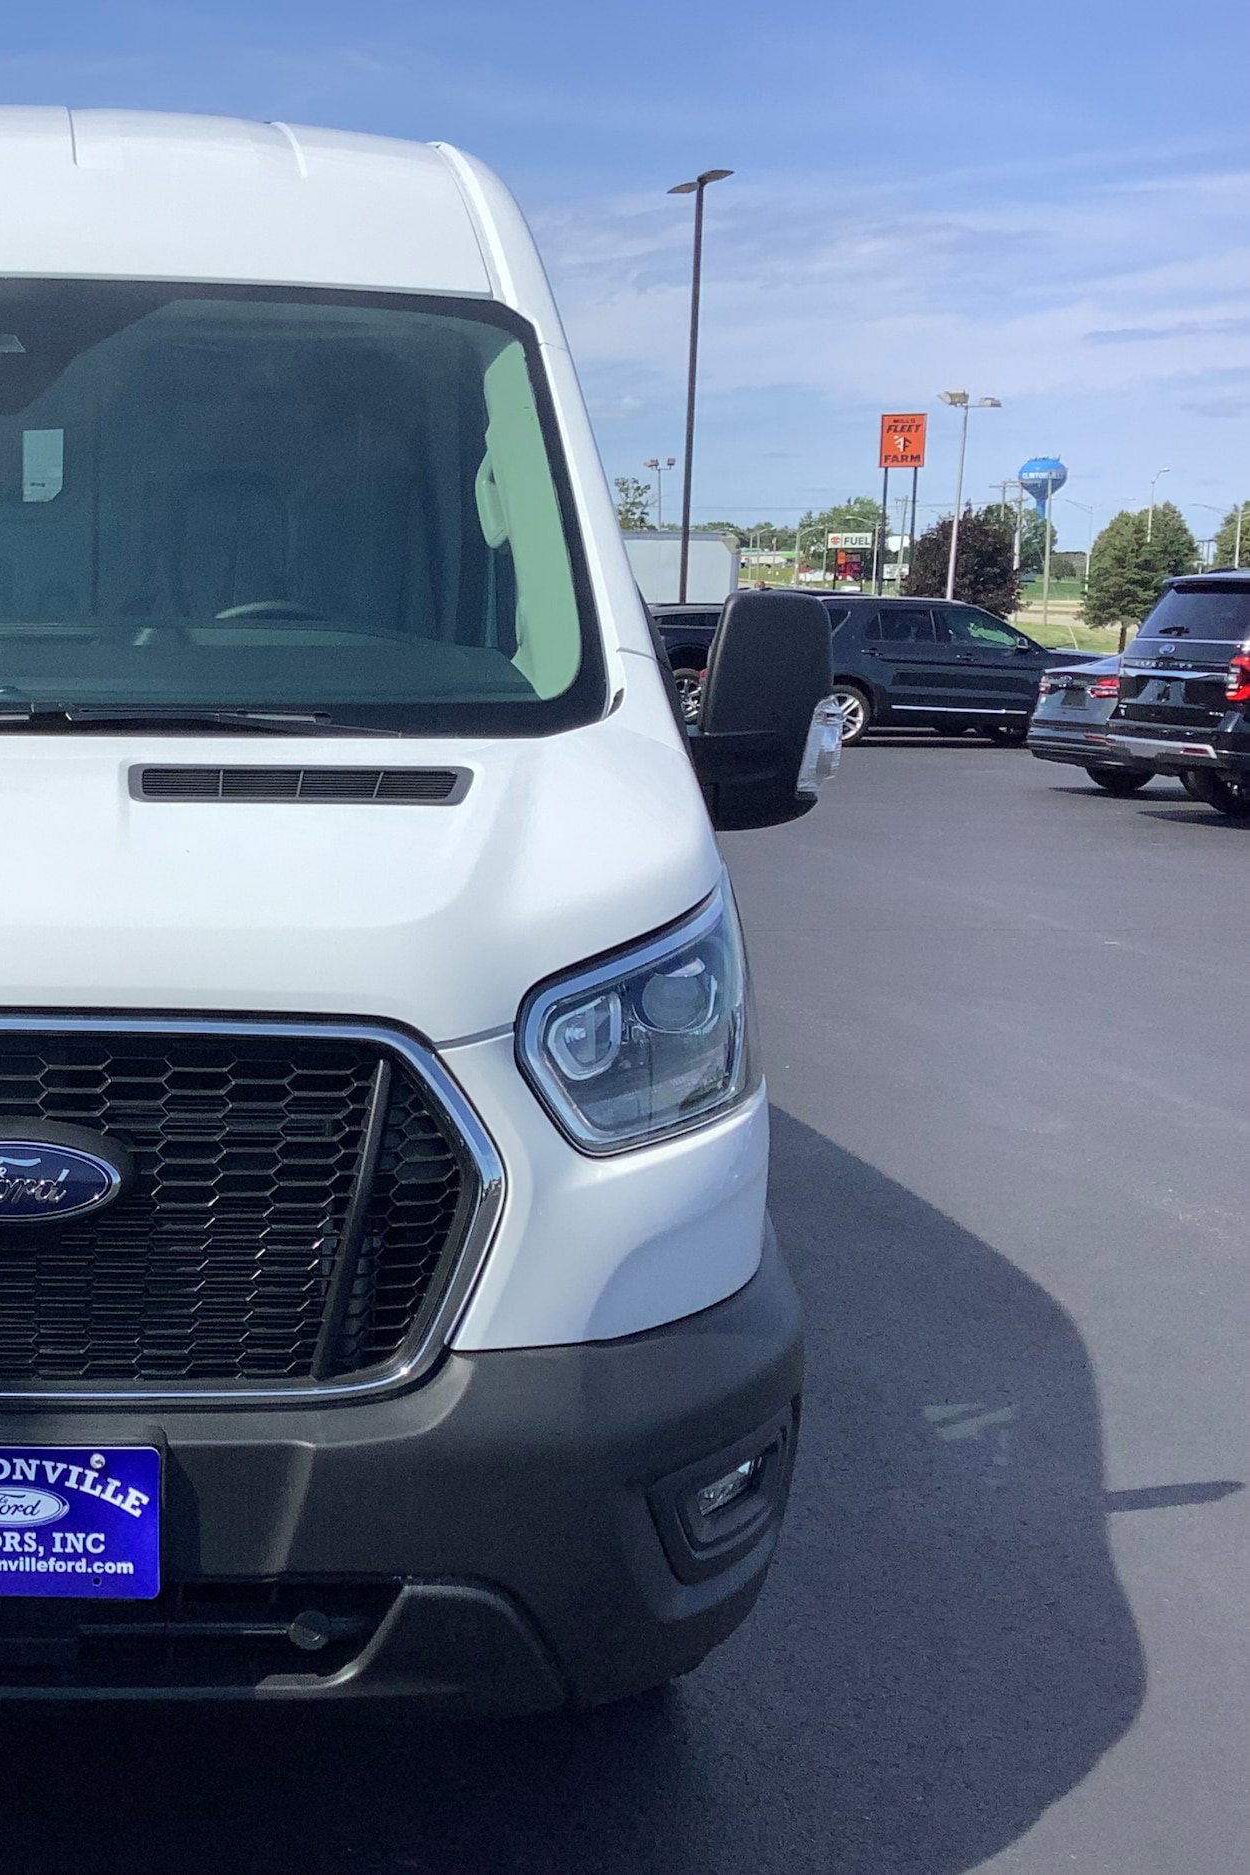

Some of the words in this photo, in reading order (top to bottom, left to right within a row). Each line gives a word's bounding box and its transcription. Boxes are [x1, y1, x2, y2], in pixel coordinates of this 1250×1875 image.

[886, 424, 922, 433] FLEET
[884, 454, 921, 463] FARM
[844, 536, 871, 546] FUEL
[52, 1532, 106, 1554] INC
